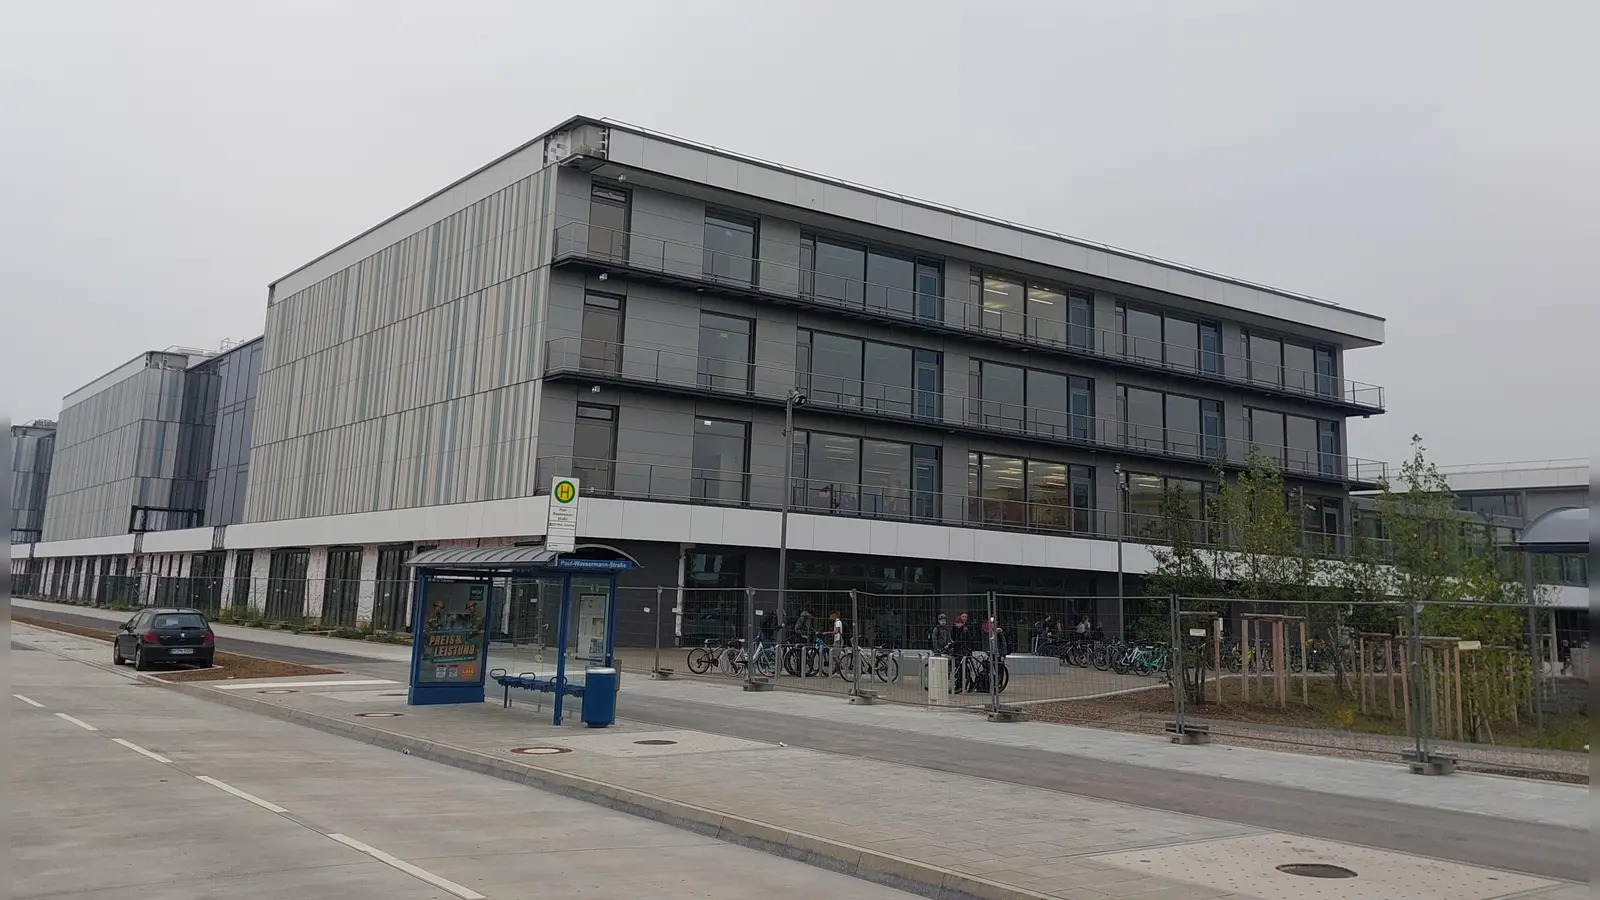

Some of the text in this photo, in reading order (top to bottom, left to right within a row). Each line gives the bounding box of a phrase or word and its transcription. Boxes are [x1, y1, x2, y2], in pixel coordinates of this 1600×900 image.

[561, 486, 569, 498] H
[560, 560, 627, 568] Paul-Wassermann-Straße
[434, 645, 475, 656] LEISTUNG
